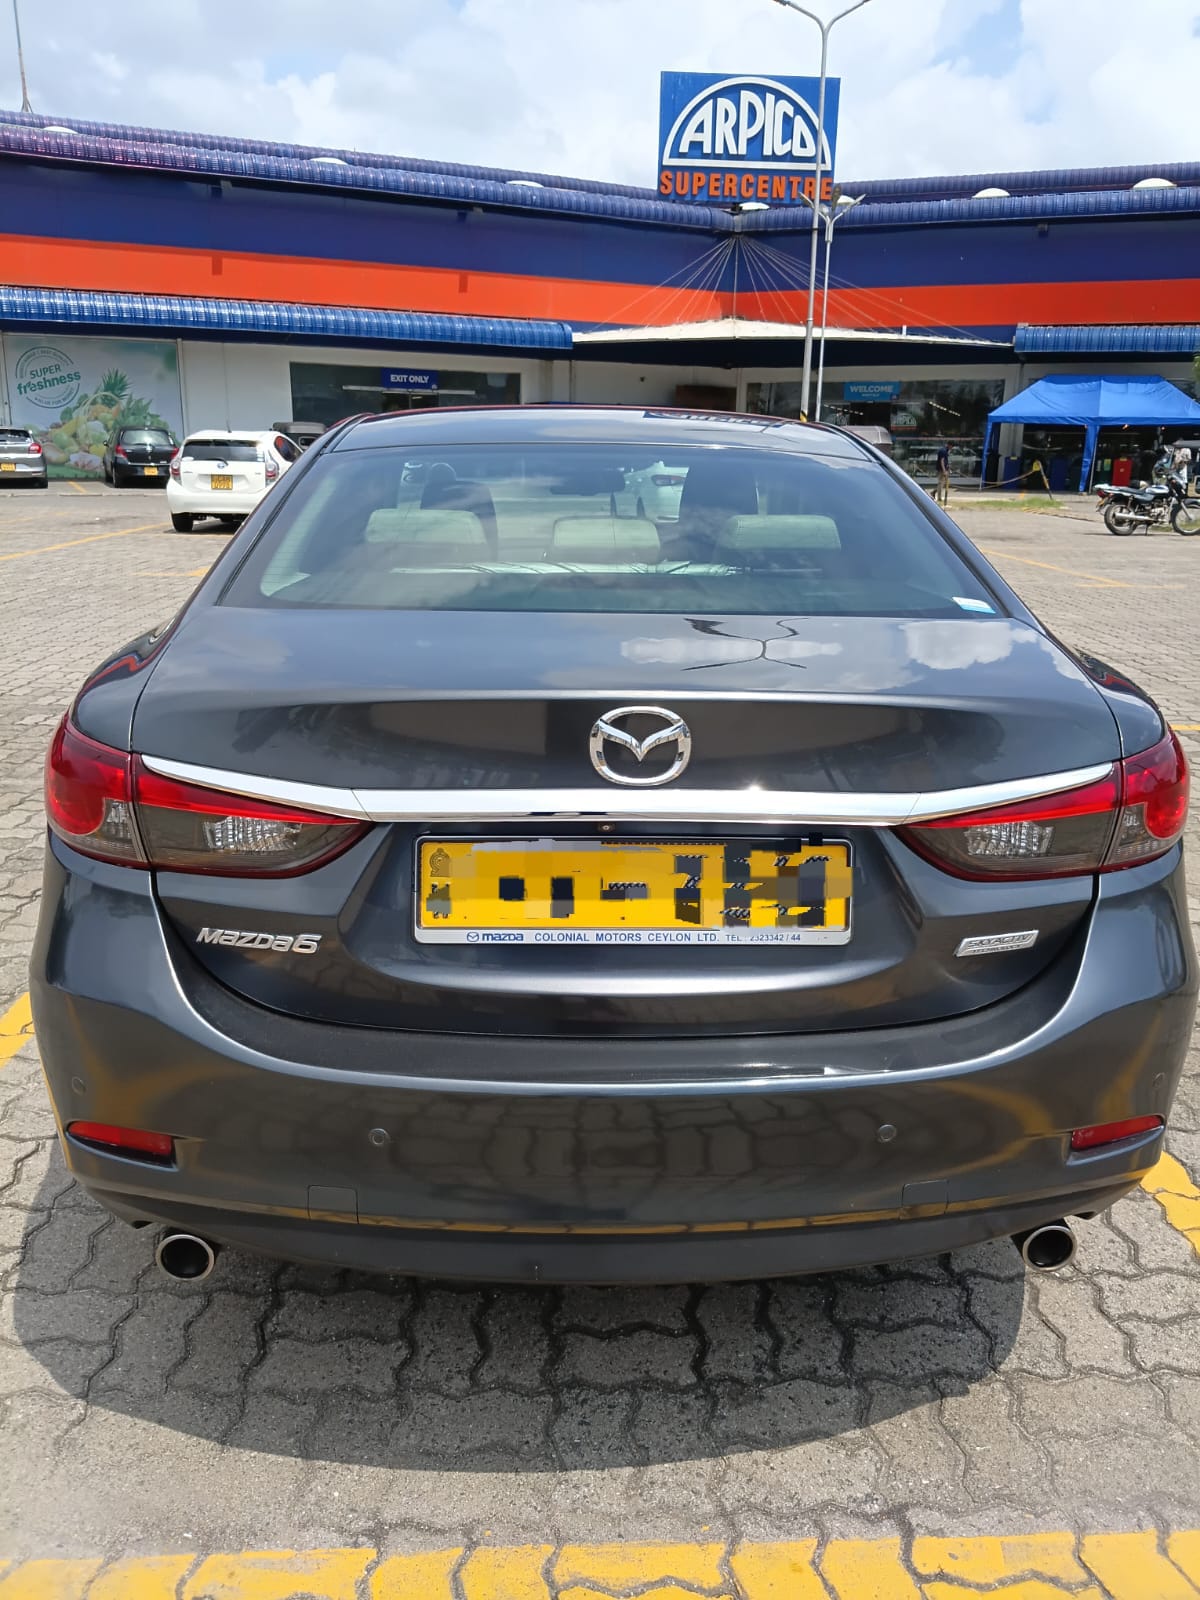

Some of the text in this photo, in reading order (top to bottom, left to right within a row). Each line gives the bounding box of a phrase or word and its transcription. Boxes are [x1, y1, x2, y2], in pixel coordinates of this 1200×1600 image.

[679, 90, 816, 157] ARPICO
[660, 170, 833, 200] SUPERCENTRE
[30, 363, 61, 379] SUPER
[390, 374, 429, 383] EXIT ONLY
[17, 371, 81, 395] freshness
[849, 385, 894, 393] WELCOME
[535, 932, 589, 942] COLONIAL
[595, 932, 642, 942] MOTORS
[647, 932, 691, 942] CEYLON
[697, 932, 720, 942] LTD.
